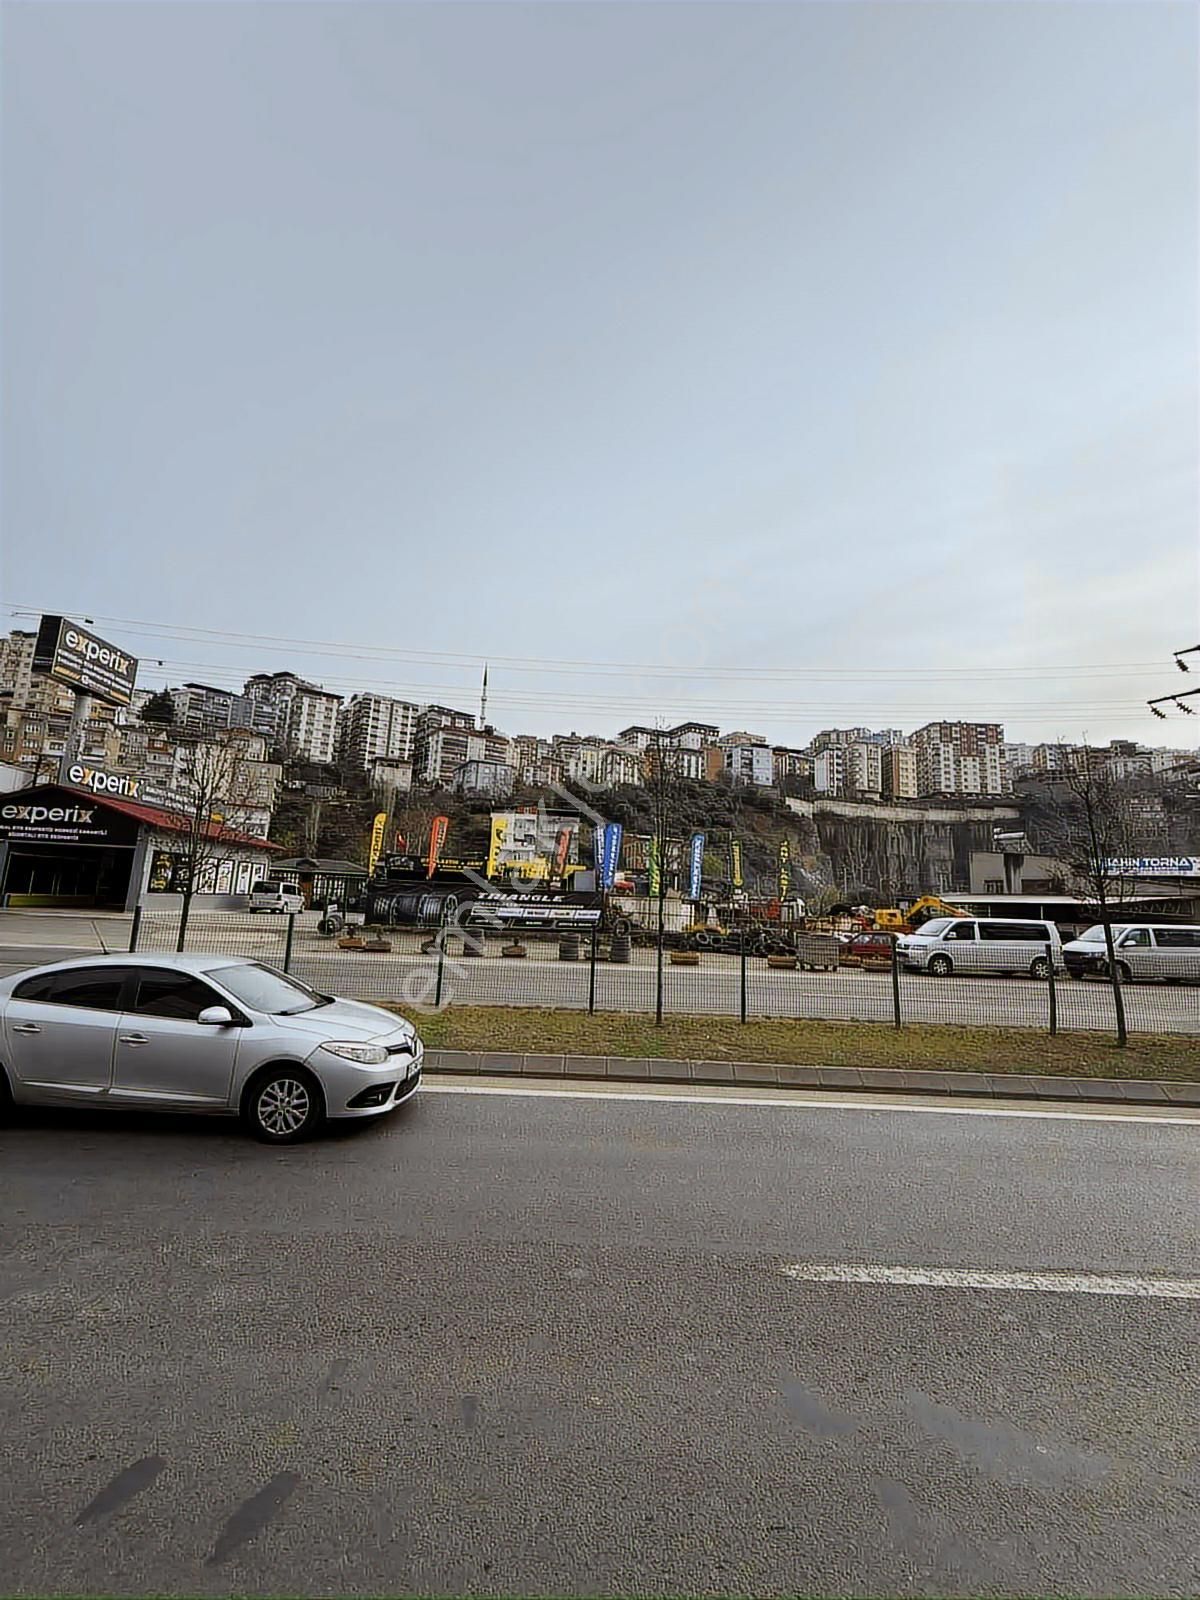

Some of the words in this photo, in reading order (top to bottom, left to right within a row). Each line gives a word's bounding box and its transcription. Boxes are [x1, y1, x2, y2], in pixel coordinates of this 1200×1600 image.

[65, 630, 129, 675] experix
[69, 764, 140, 798] experix
[1, 805, 94, 823] experix
[1142, 857, 1191, 867] TORNA
[477, 892, 565, 902] TRIANGLE
